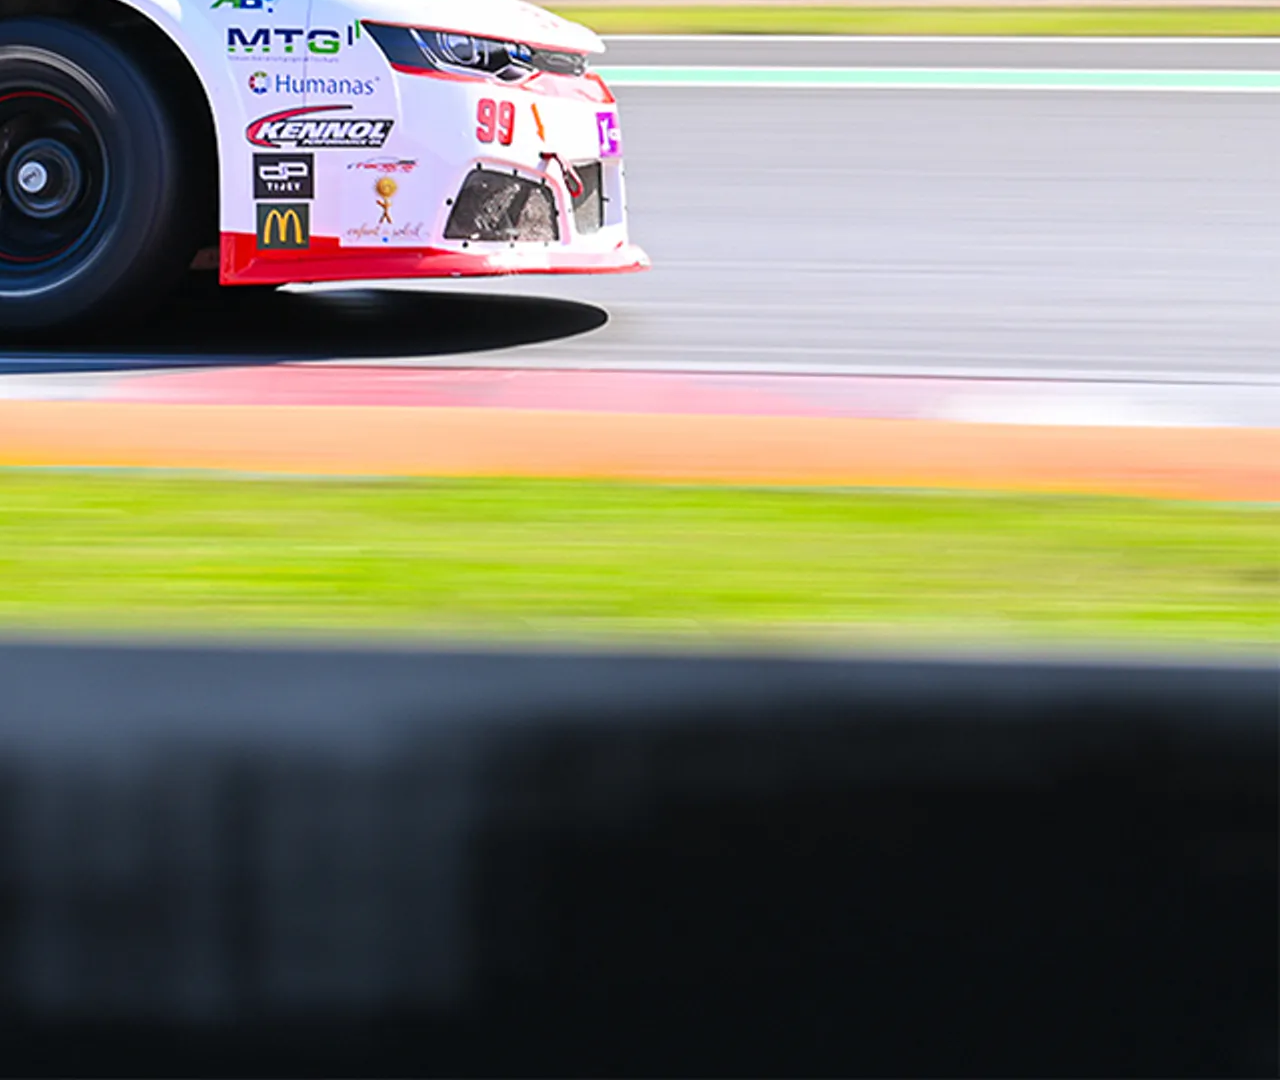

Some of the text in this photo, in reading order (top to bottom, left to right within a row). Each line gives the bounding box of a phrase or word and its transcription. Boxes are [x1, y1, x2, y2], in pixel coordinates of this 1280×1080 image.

[228, 28, 340, 53] MTG
[276, 74, 374, 95] Humanas
[254, 122, 386, 139] KENNOL
[476, 98, 515, 146] 99
